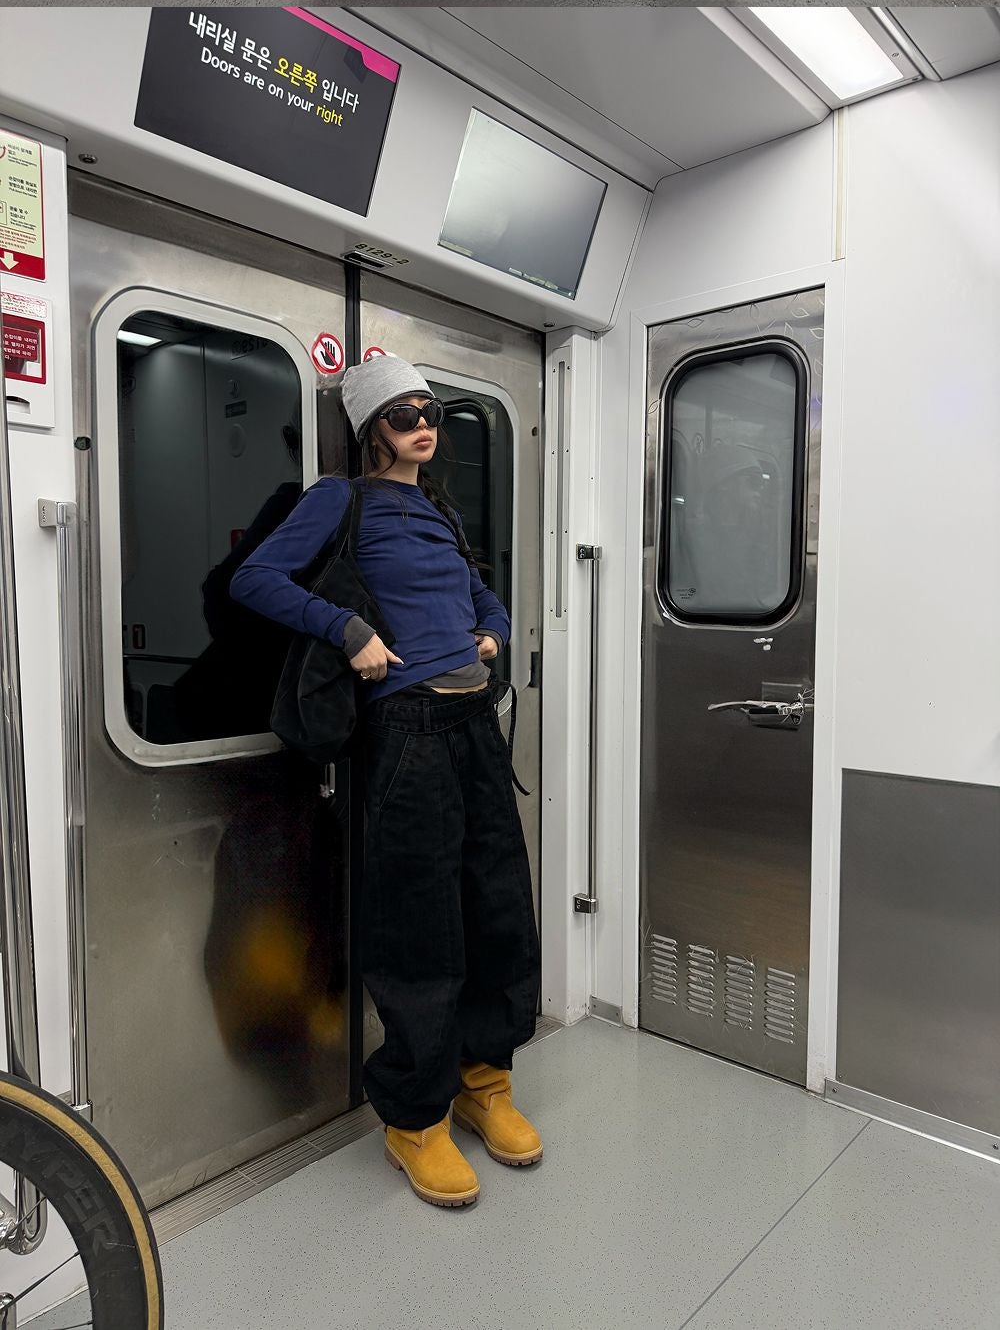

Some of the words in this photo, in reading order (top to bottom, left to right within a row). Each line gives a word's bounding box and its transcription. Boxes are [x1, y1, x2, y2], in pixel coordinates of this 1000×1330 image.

[189, 11, 237, 54] 내리실
[241, 38, 272, 71] 문은
[274, 57, 318, 94] 오른쪽
[322, 79, 360, 114] 입니다
[201, 46, 241, 79] Doors
[243, 71, 265, 90] are
[268, 83, 284, 100] on
[287, 91, 314, 112] your
[316, 105, 344, 127] right
[354, 243, 410, 265] 8129-2
